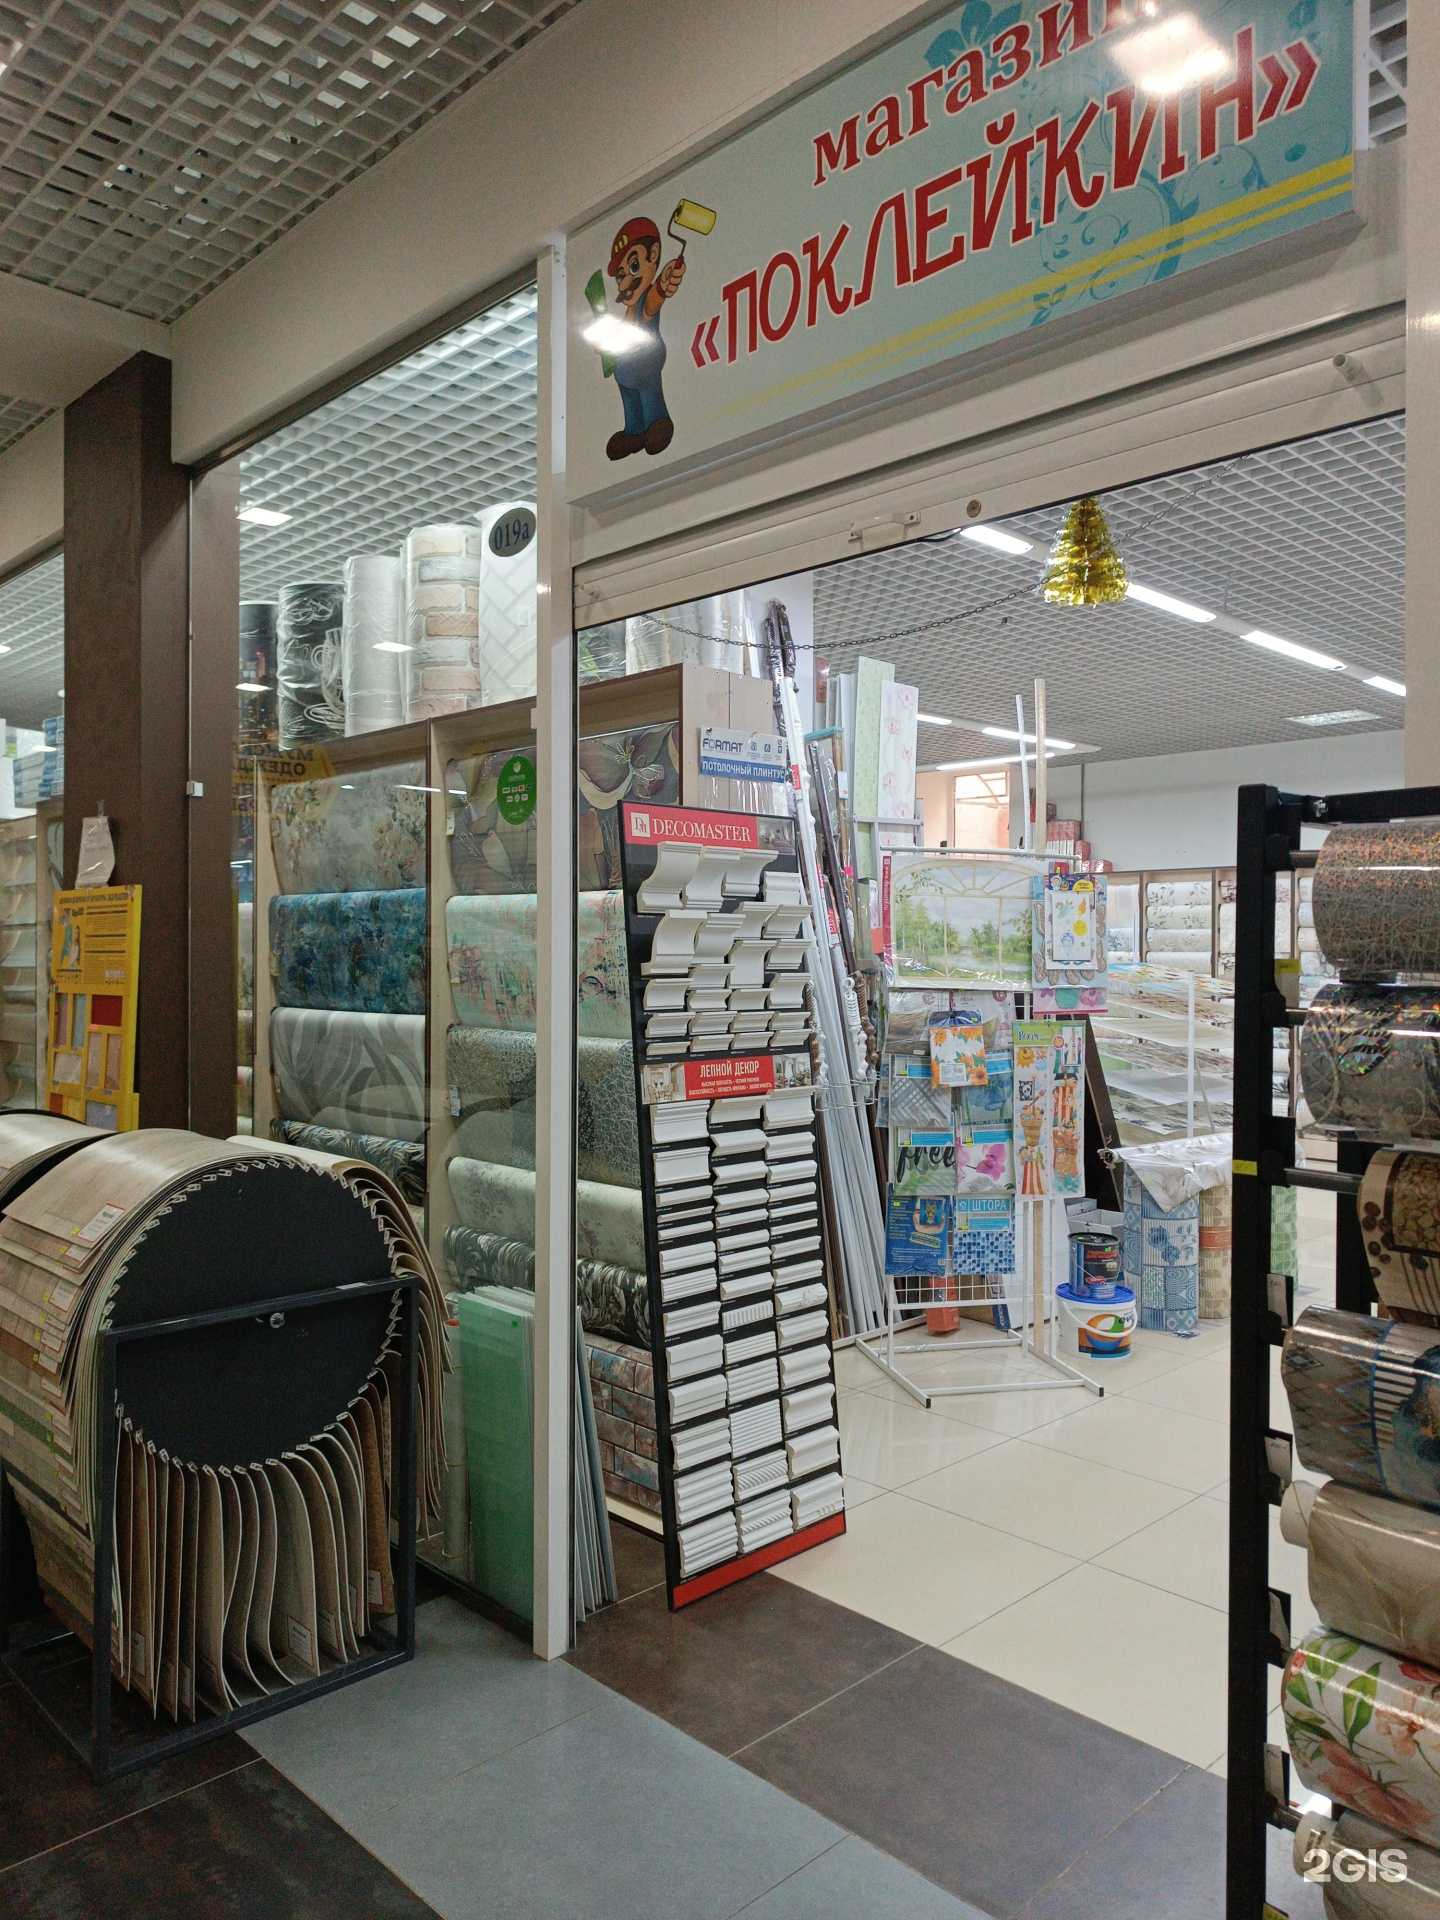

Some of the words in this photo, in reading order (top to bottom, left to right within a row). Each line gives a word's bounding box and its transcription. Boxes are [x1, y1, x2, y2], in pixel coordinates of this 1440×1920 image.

[702, 760, 752, 776] ПОТОЛОЧНЫЙ
[652, 818, 752, 843] DECOMASTER
[700, 1061, 733, 1078] ЛЕПНОЙ
[735, 1060, 760, 1076] ДЕКОР
[971, 1200, 1008, 1212] ШТОРА
